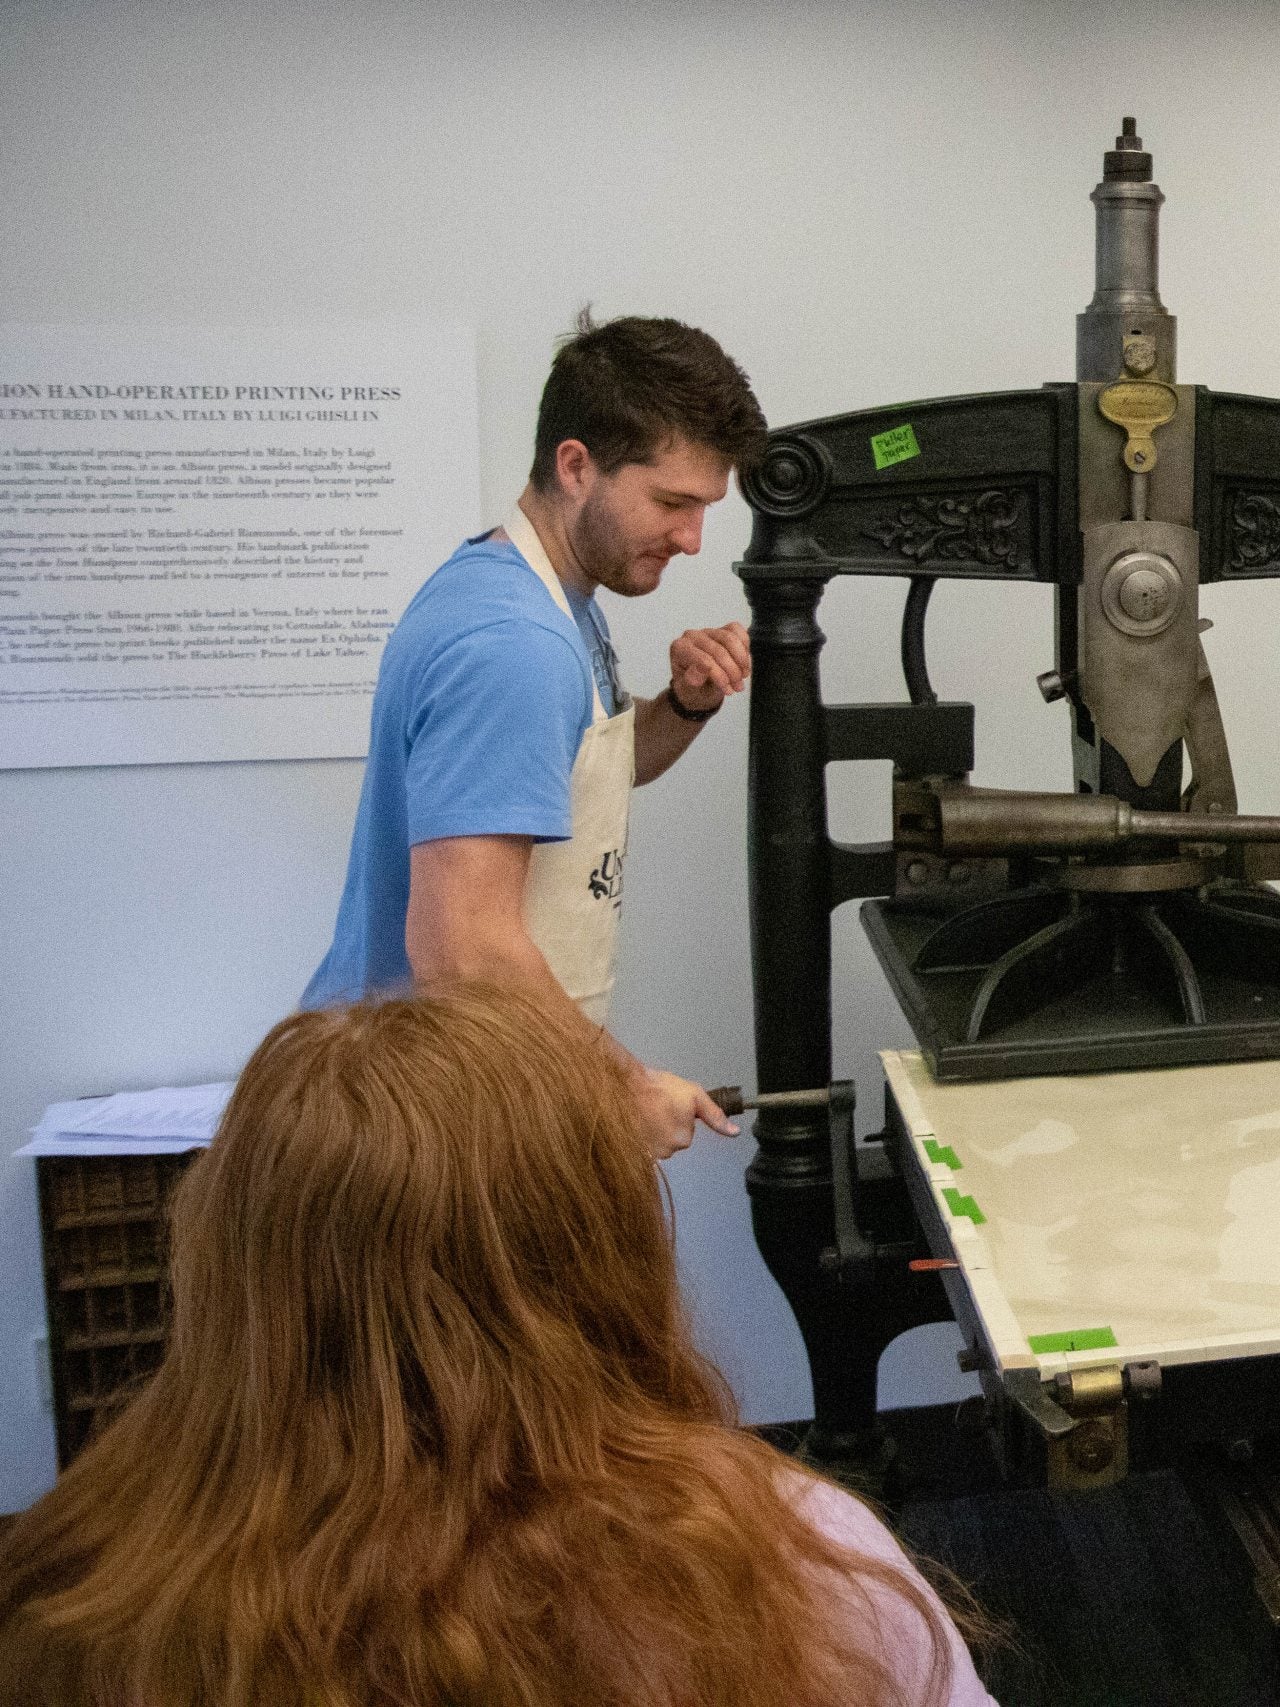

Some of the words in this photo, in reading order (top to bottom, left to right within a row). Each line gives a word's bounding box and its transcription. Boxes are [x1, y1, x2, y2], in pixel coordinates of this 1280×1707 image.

[49, 385, 229, 400] HAND-OPERATED
[235, 386, 335, 400] PRINTING
[341, 387, 401, 400] PRESS
[101, 409, 118, 420] IN
[183, 410, 227, 421] ITALY
[233, 410, 253, 421] BY
[259, 410, 302, 421] LUIGI
